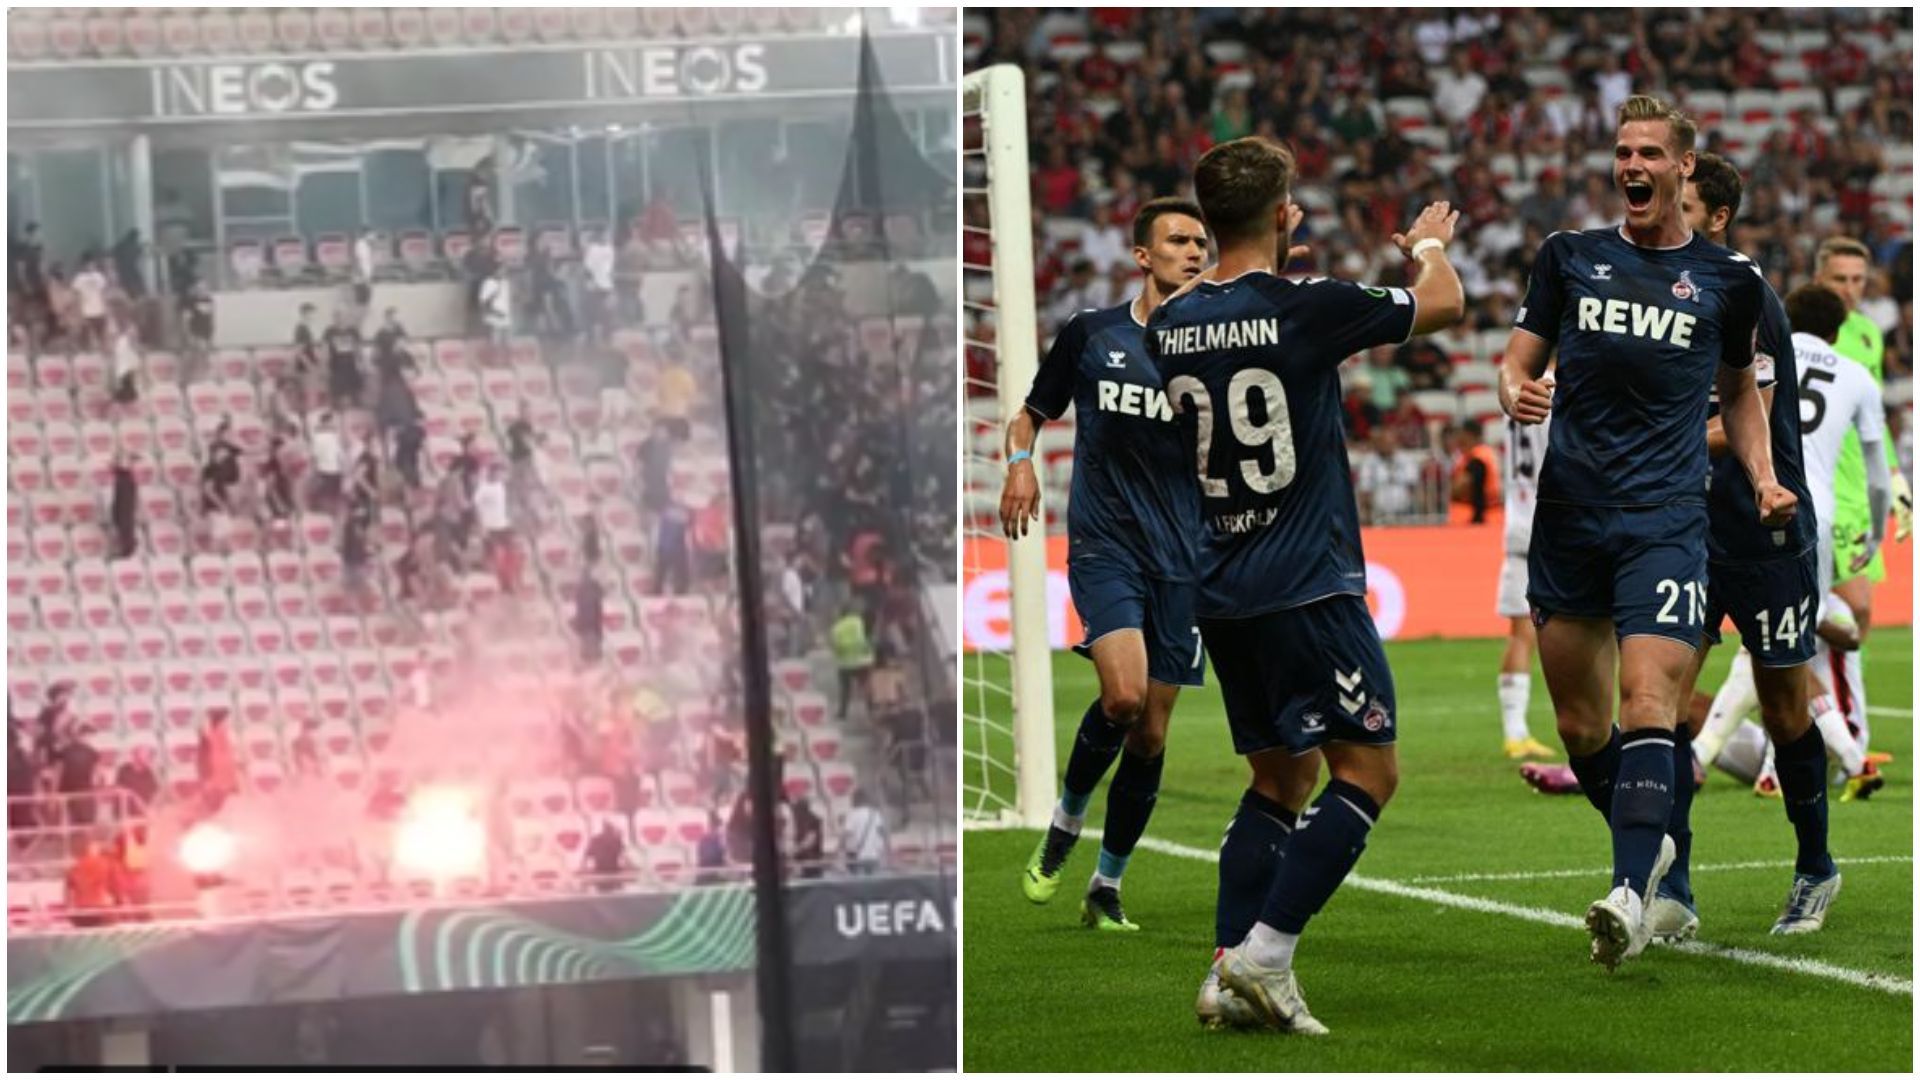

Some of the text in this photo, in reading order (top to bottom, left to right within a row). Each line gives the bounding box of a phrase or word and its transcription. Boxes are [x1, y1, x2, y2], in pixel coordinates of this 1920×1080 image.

[152, 63, 338, 116] INEOS
[583, 45, 767, 98] INEOS
[1157, 318, 1278, 355] THIELMANN
[1579, 297, 1696, 349] REWE
[1168, 367, 1297, 497] 29
[1656, 579, 1697, 626] 21
[1755, 606, 1799, 651] 14
[836, 899, 944, 936] UEFA
